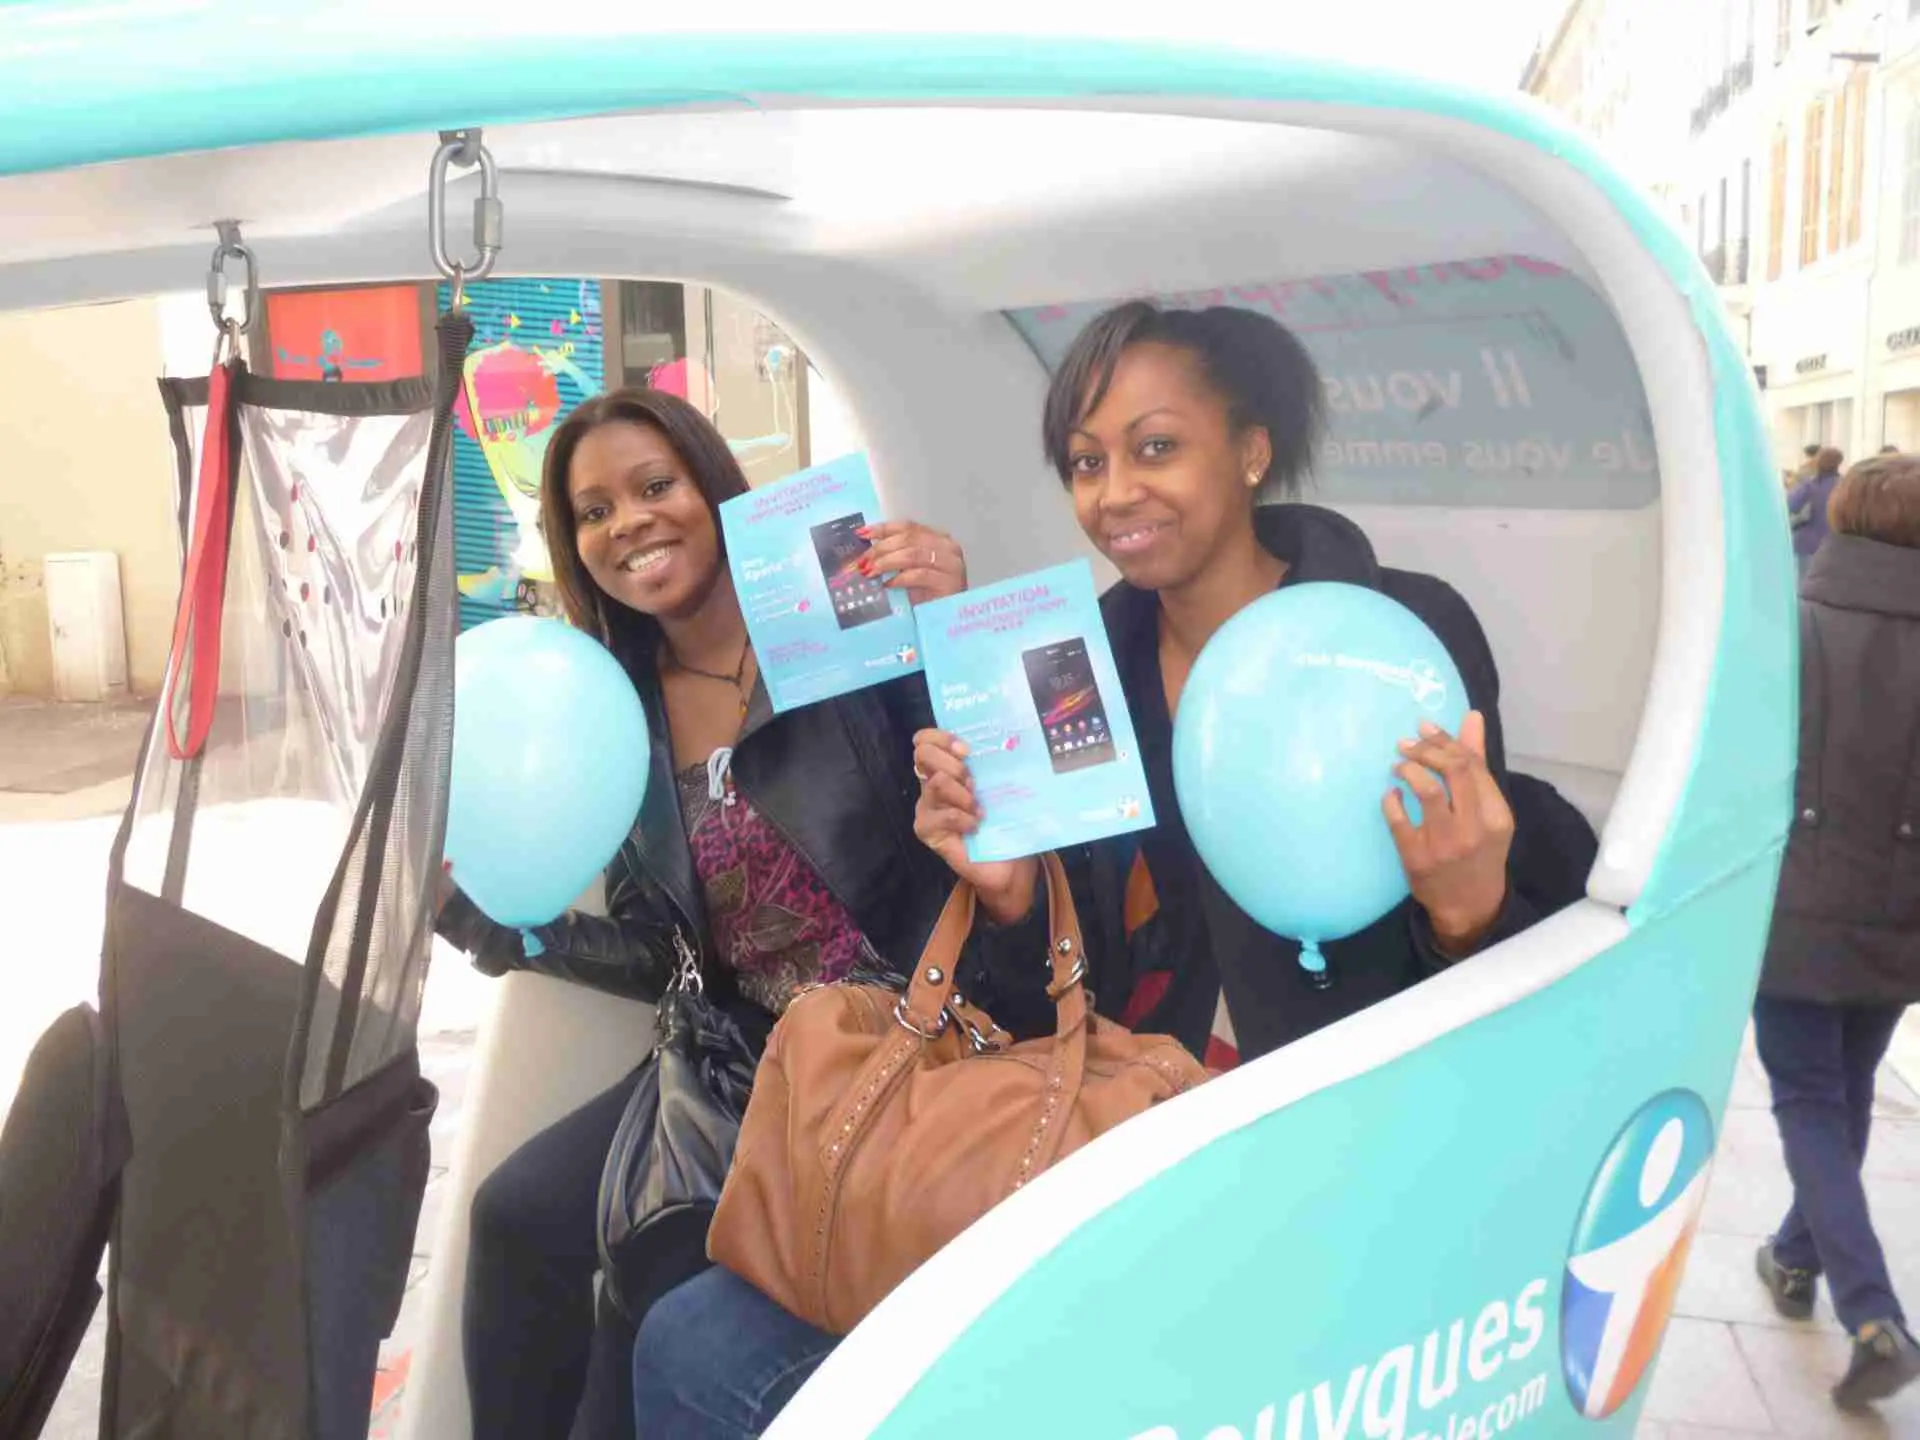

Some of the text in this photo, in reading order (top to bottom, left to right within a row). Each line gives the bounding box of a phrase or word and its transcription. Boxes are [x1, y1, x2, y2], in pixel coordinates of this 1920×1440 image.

[958, 584, 1049, 620] INVITATION
[1127, 1278, 1548, 1440] uygues
[1406, 1372, 1548, 1440] lecom
